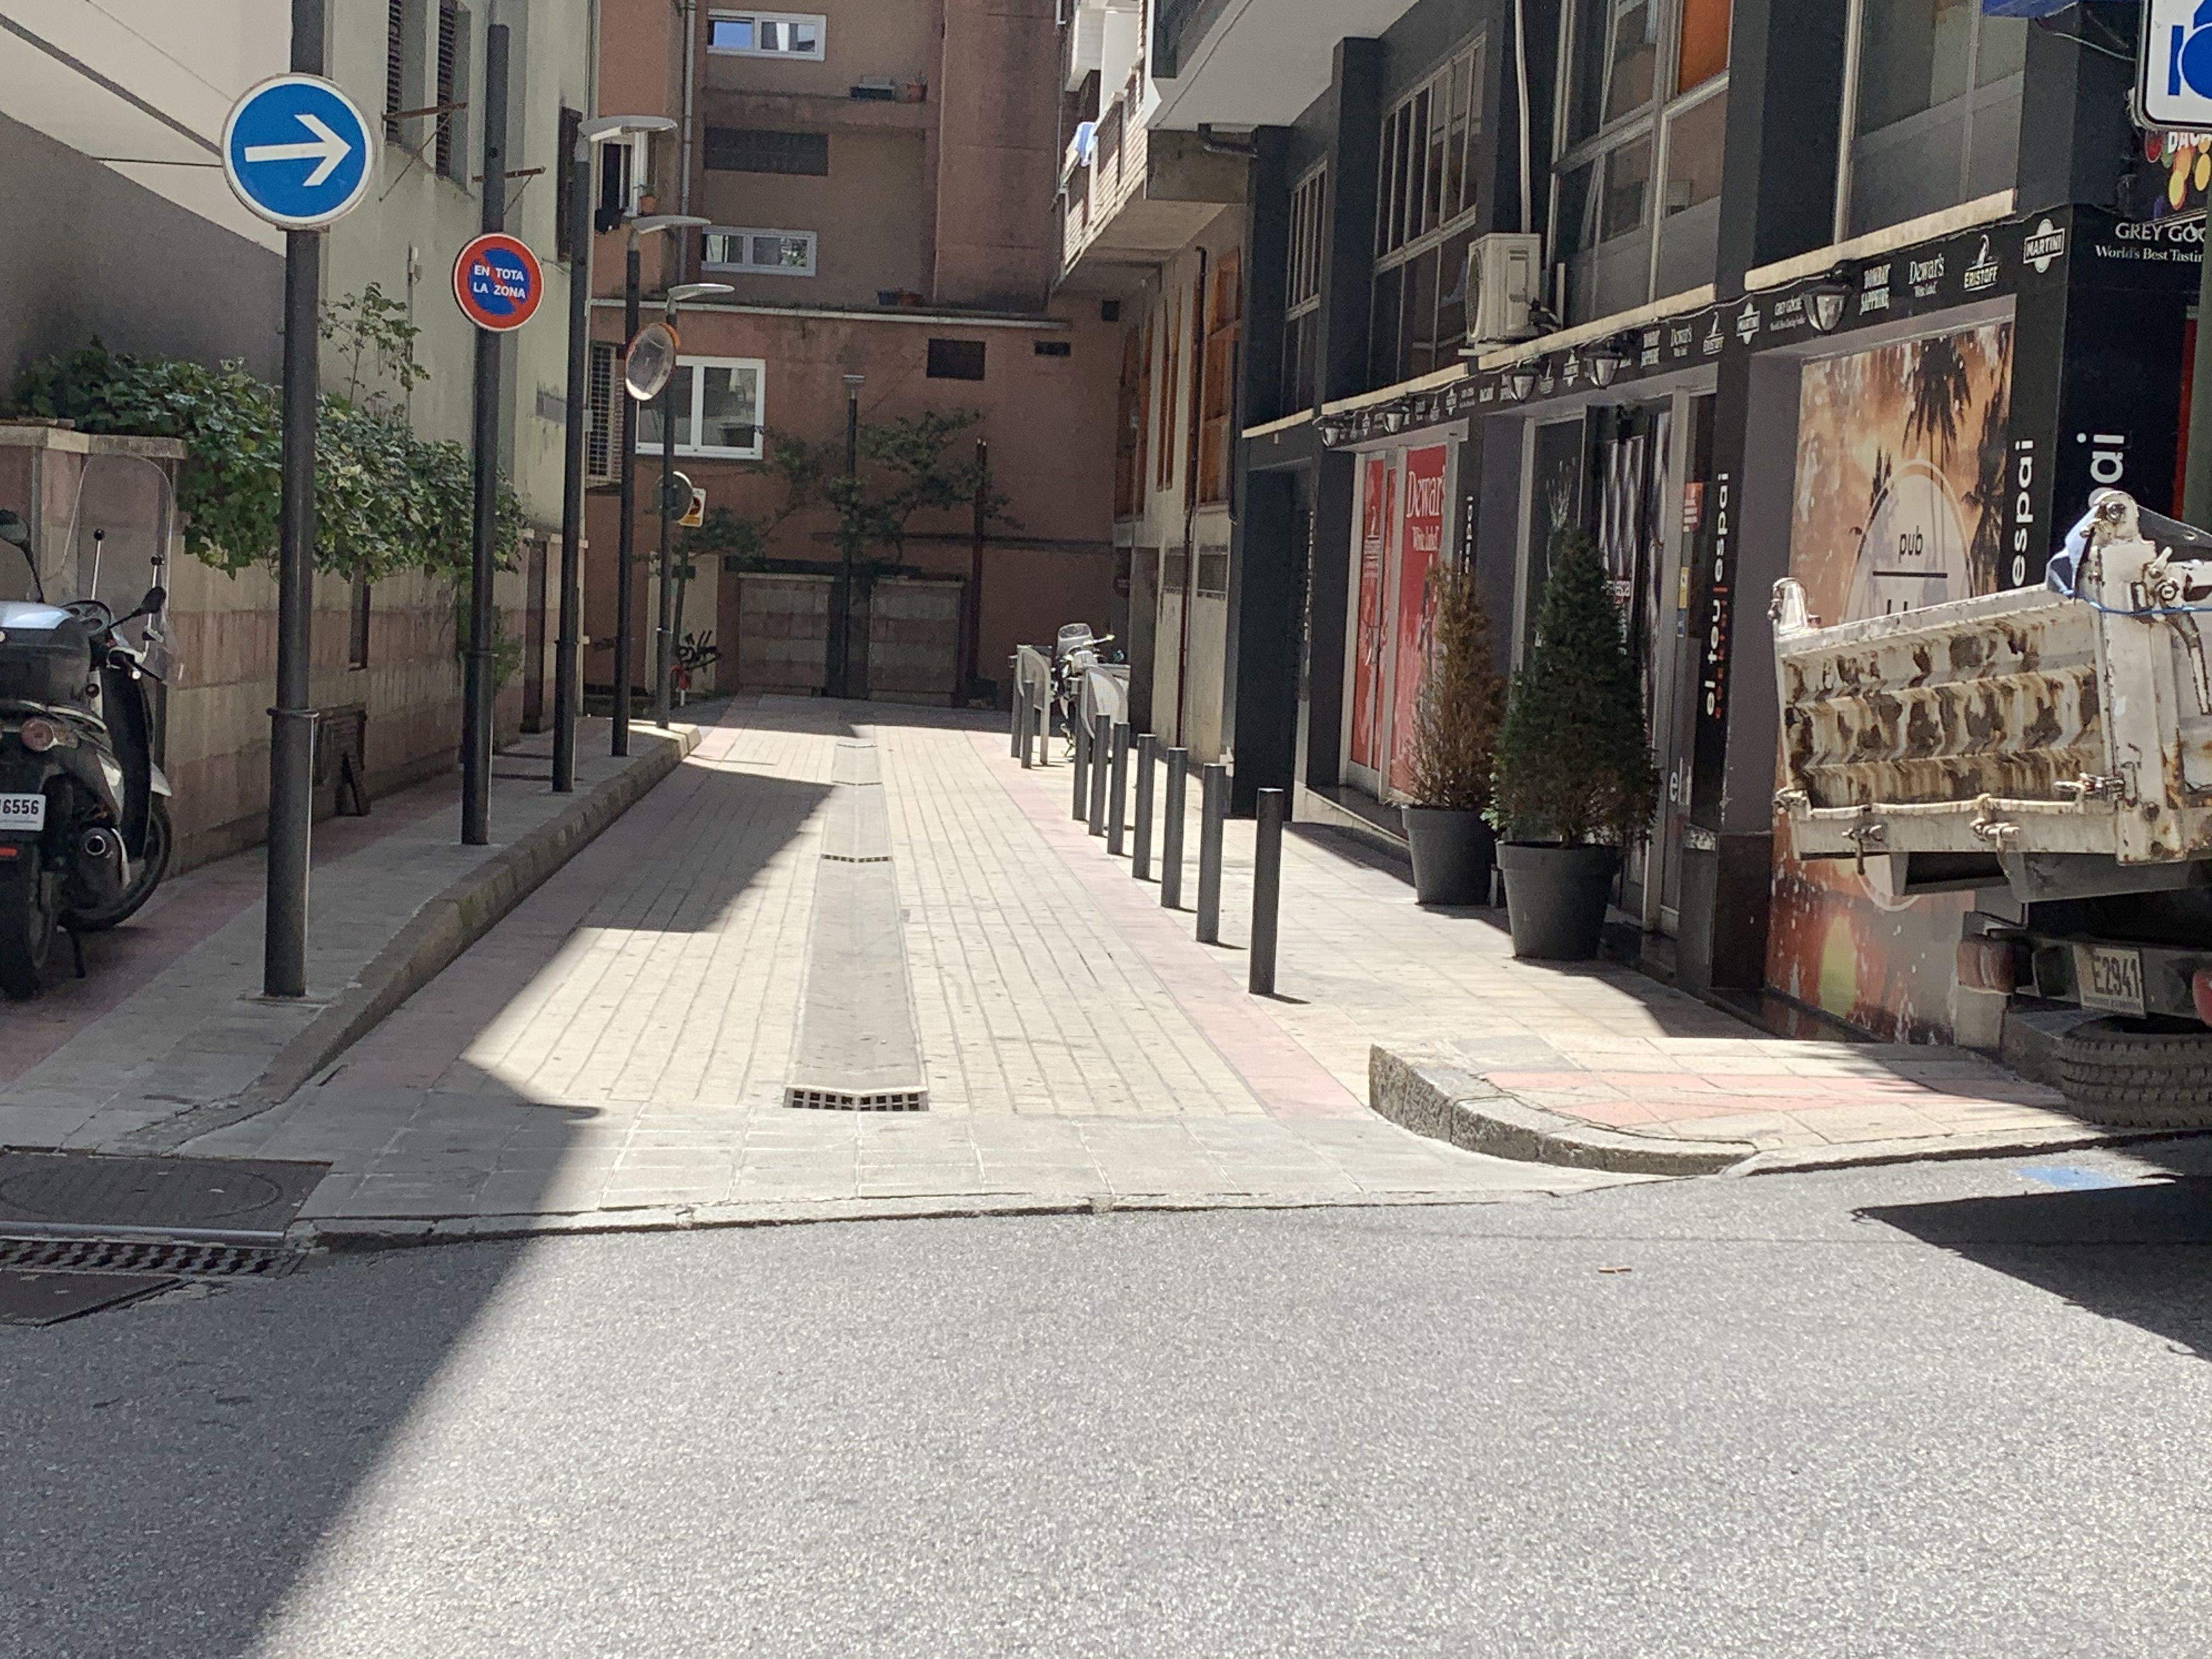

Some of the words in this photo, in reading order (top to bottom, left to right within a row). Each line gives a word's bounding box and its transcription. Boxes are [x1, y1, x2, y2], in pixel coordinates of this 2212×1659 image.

[2115, 222, 2163, 241] GREY
[2026, 234, 2062, 257] MARTINI
[2095, 245, 2140, 259] World's
[2143, 248, 2168, 261] Best
[474, 265, 490, 276] EN
[495, 267, 524, 281] TOTA
[1908, 252, 1945, 284] Dewar's
[473, 281, 489, 294] LA
[493, 284, 526, 299] ZONA
[2012, 440, 2034, 586] espai
[1898, 524, 1923, 564] pub
[1705, 680, 1716, 716] el
[1714, 473, 1728, 583] espai
[0, 799, 39, 815] 6556
